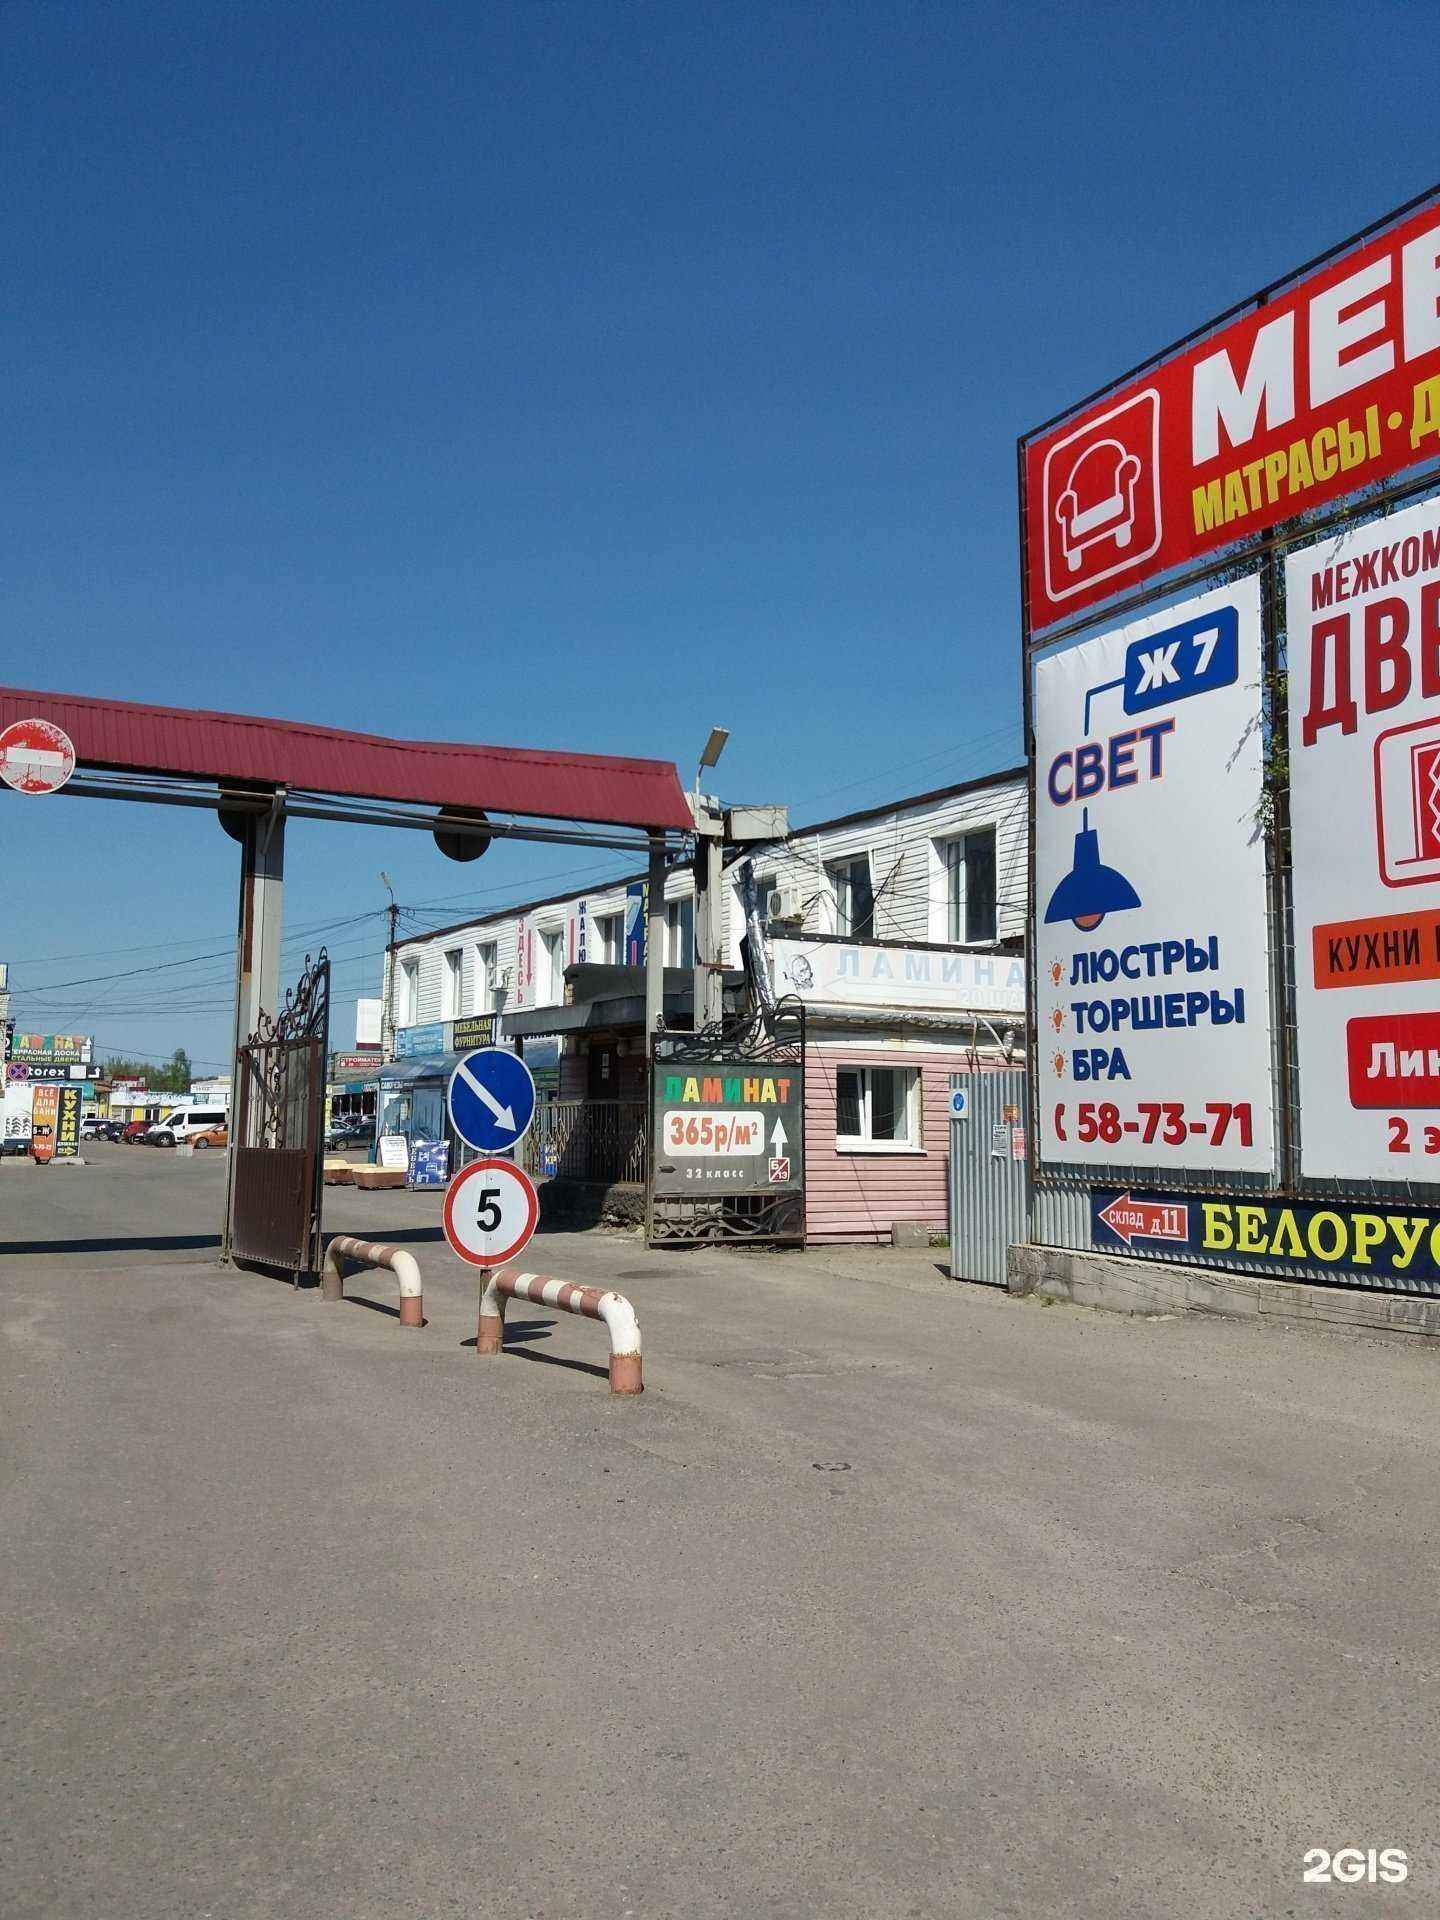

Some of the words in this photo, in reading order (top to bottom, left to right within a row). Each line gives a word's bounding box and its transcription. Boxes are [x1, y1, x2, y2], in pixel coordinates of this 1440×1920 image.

[1192, 404, 1381, 535] МАТРАСЫ
[1135, 641, 1181, 695] Ж
[1193, 628, 1219, 676] 7
[1047, 717, 1176, 808] СВЕТ
[1069, 936, 1219, 985] ЛЮСТРЫ
[1328, 928, 1421, 973] КУХНИ
[454, 1018, 492, 1033] МЕБЕЛЬНАЯ
[1070, 988, 1245, 1034] ТОРШЕРЫ
[454, 1033, 490, 1048] ФУРНИТУРА
[28, 1066, 65, 1076] torex
[1072, 1047, 1132, 1081] БРА
[663, 1077, 791, 1104] ЛАМИНАТ
[61, 1089, 77, 1142] КУХНИ
[1078, 1102, 1253, 1148] 58-73-71
[1388, 1117, 1410, 1153] 2
[686, 1169, 702, 1178] 32
[706, 1170, 744, 1178] класс
[476, 1189, 502, 1232] 5
[1202, 1203, 1440, 1269] БЕЛОРУ
